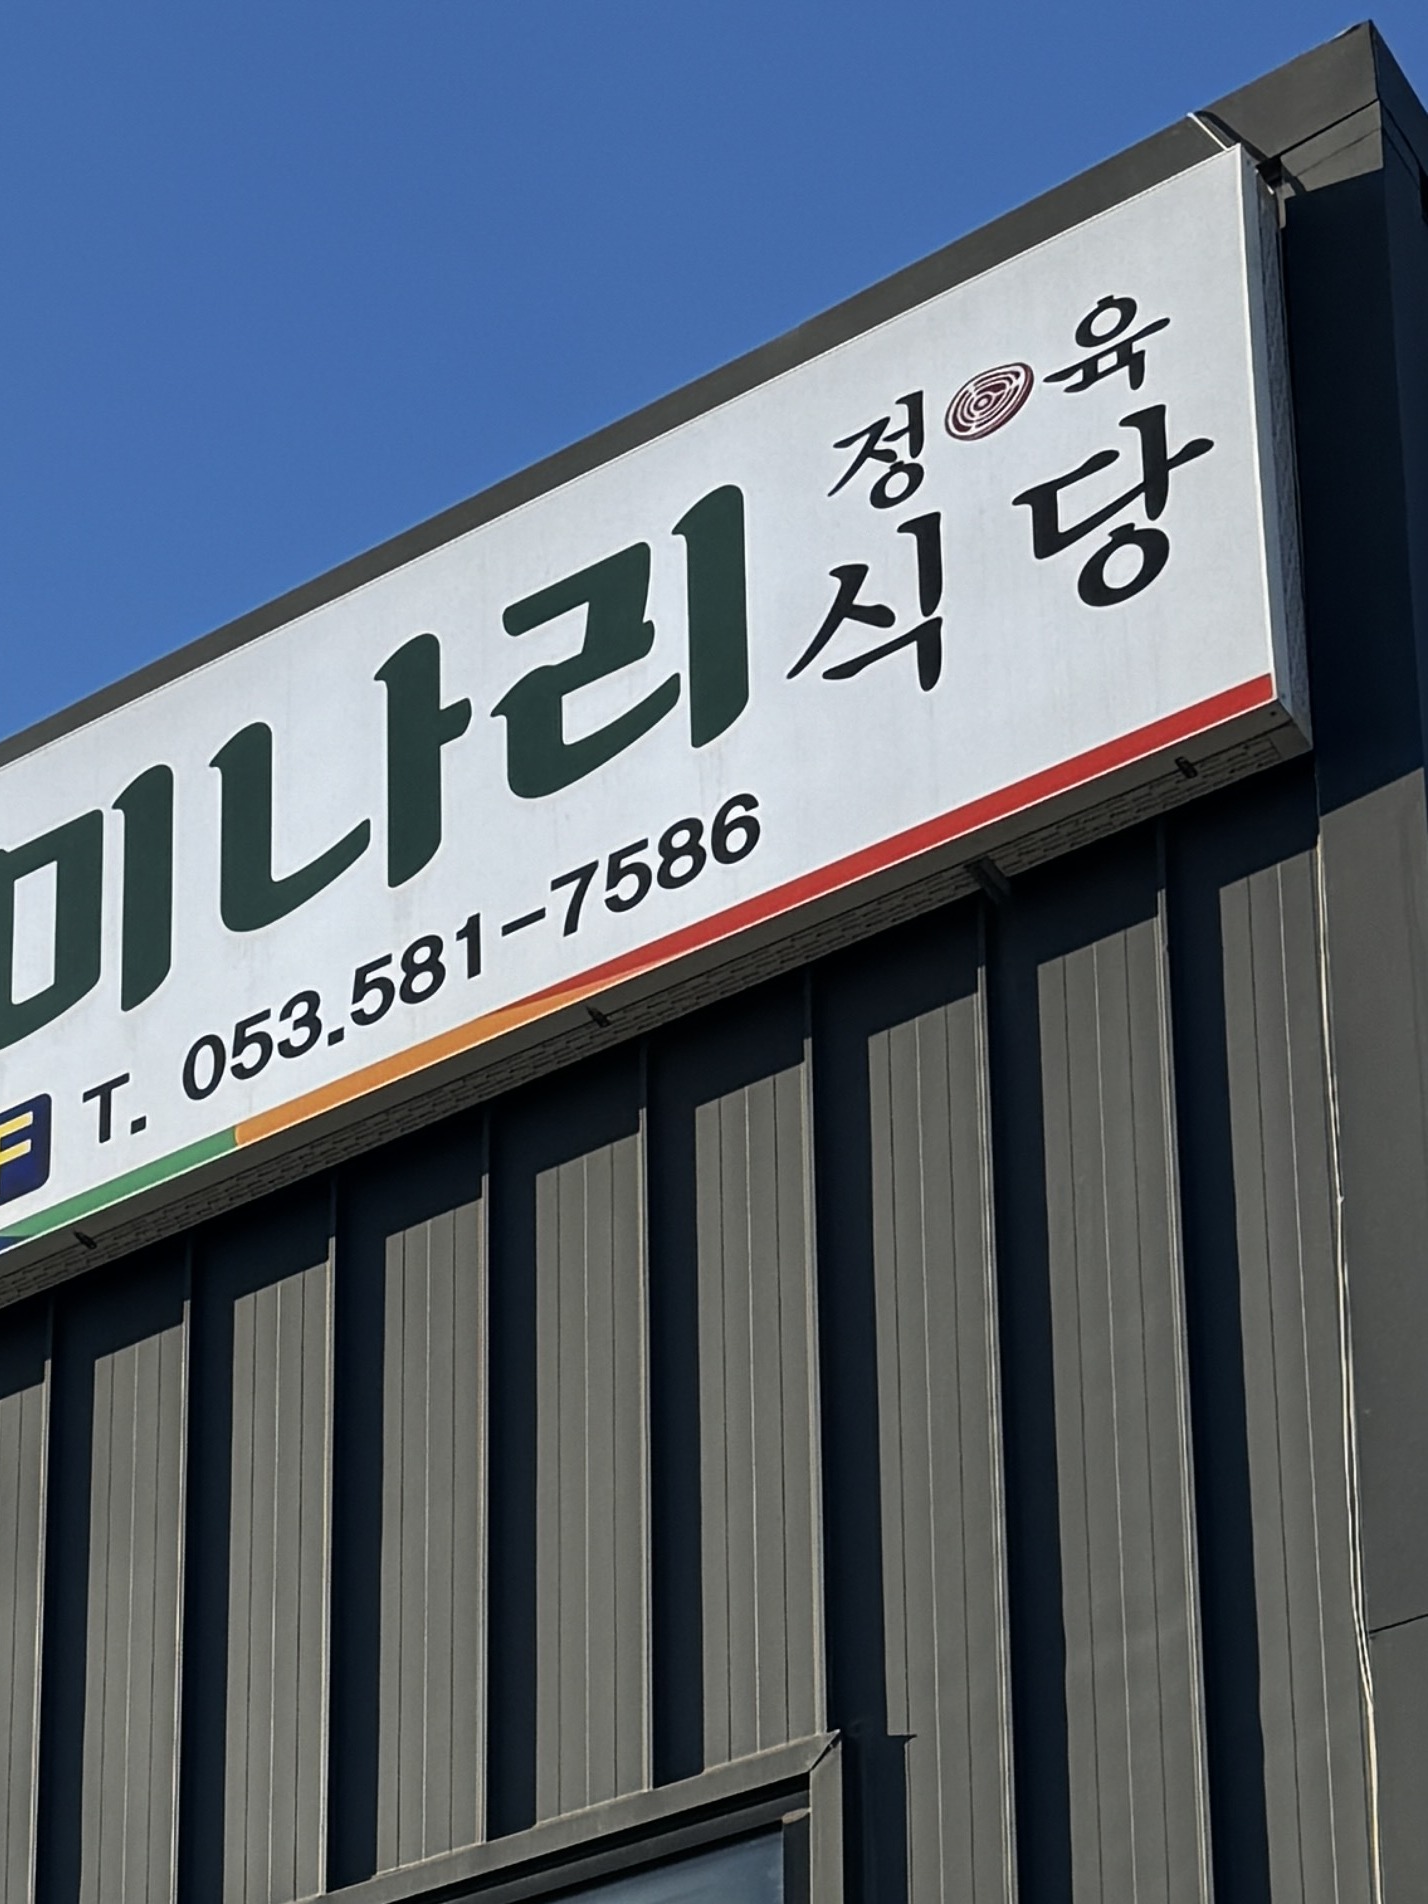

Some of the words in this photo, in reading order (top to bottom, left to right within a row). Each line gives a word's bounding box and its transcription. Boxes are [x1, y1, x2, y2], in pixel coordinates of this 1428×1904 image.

[785, 403, 1216, 693] 식당
[80, 1071, 145, 1146] T.
[181, 792, 762, 1102] 053.581-7586
